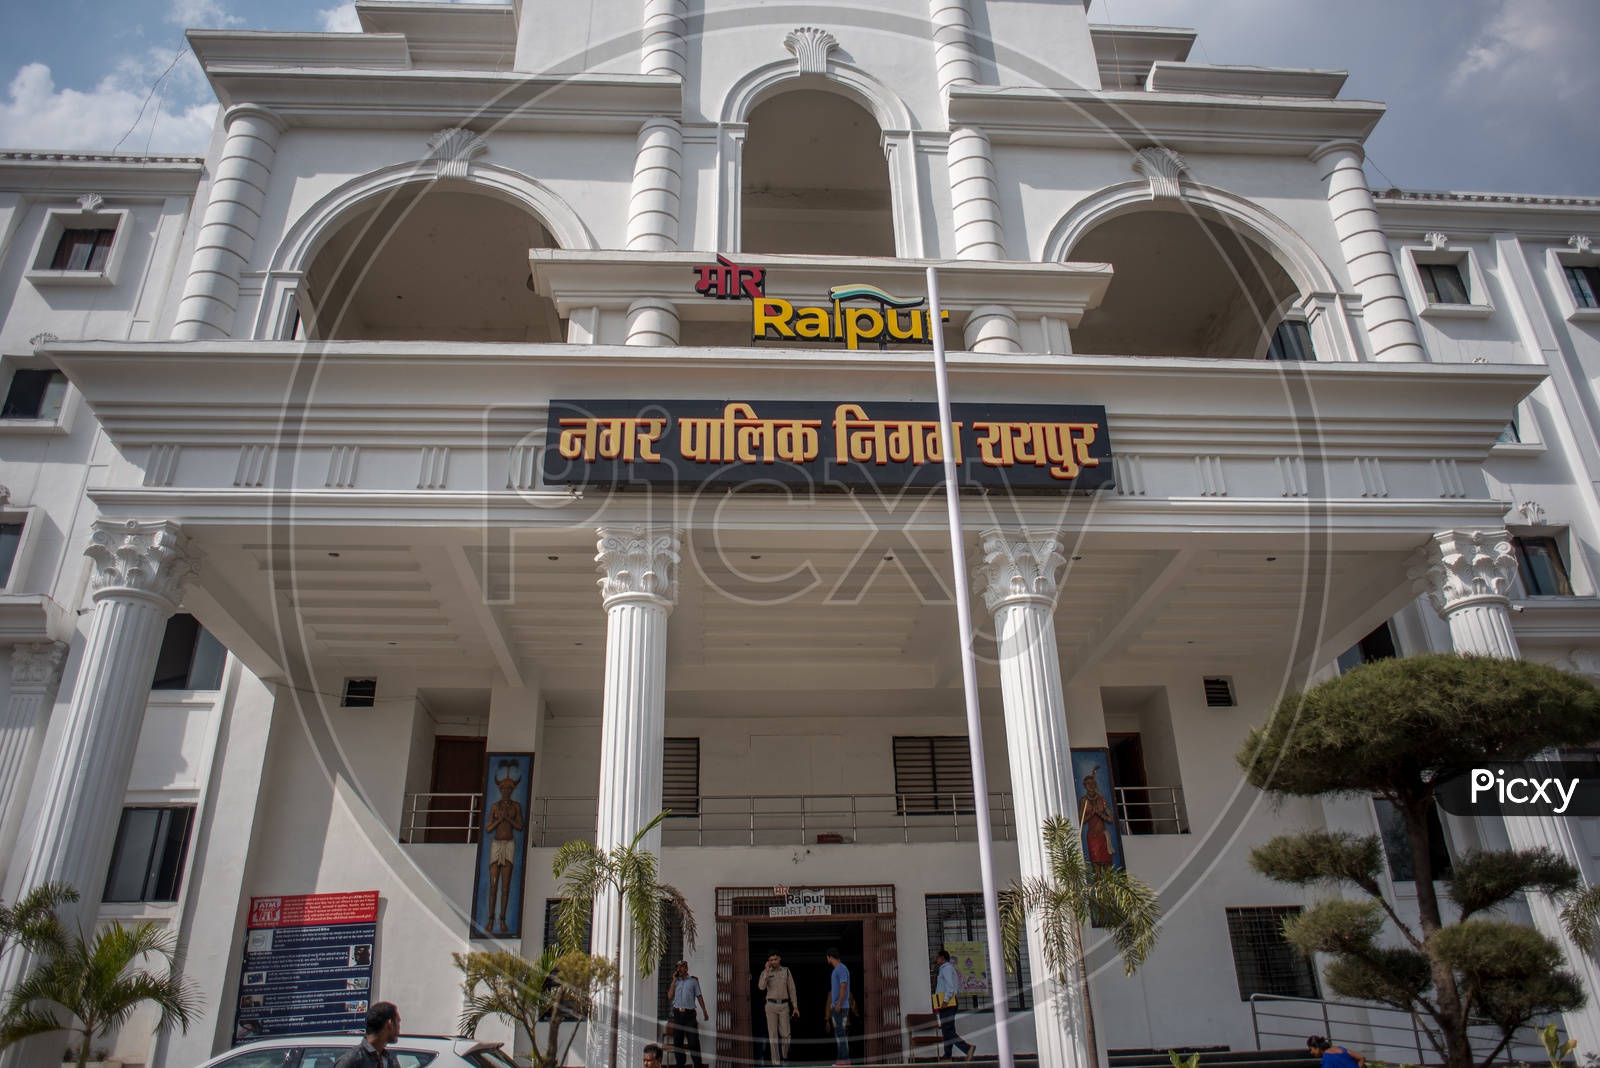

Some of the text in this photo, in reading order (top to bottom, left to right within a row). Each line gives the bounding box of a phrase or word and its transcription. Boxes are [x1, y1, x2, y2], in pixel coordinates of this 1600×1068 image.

[693, 254, 768, 301] मोर
[753, 297, 949, 351] Raipur
[559, 403, 1098, 479] नगर पालिक निगम रायपुर
[770, 906, 802, 916] SMART
[786, 891, 824, 906] Raipur
